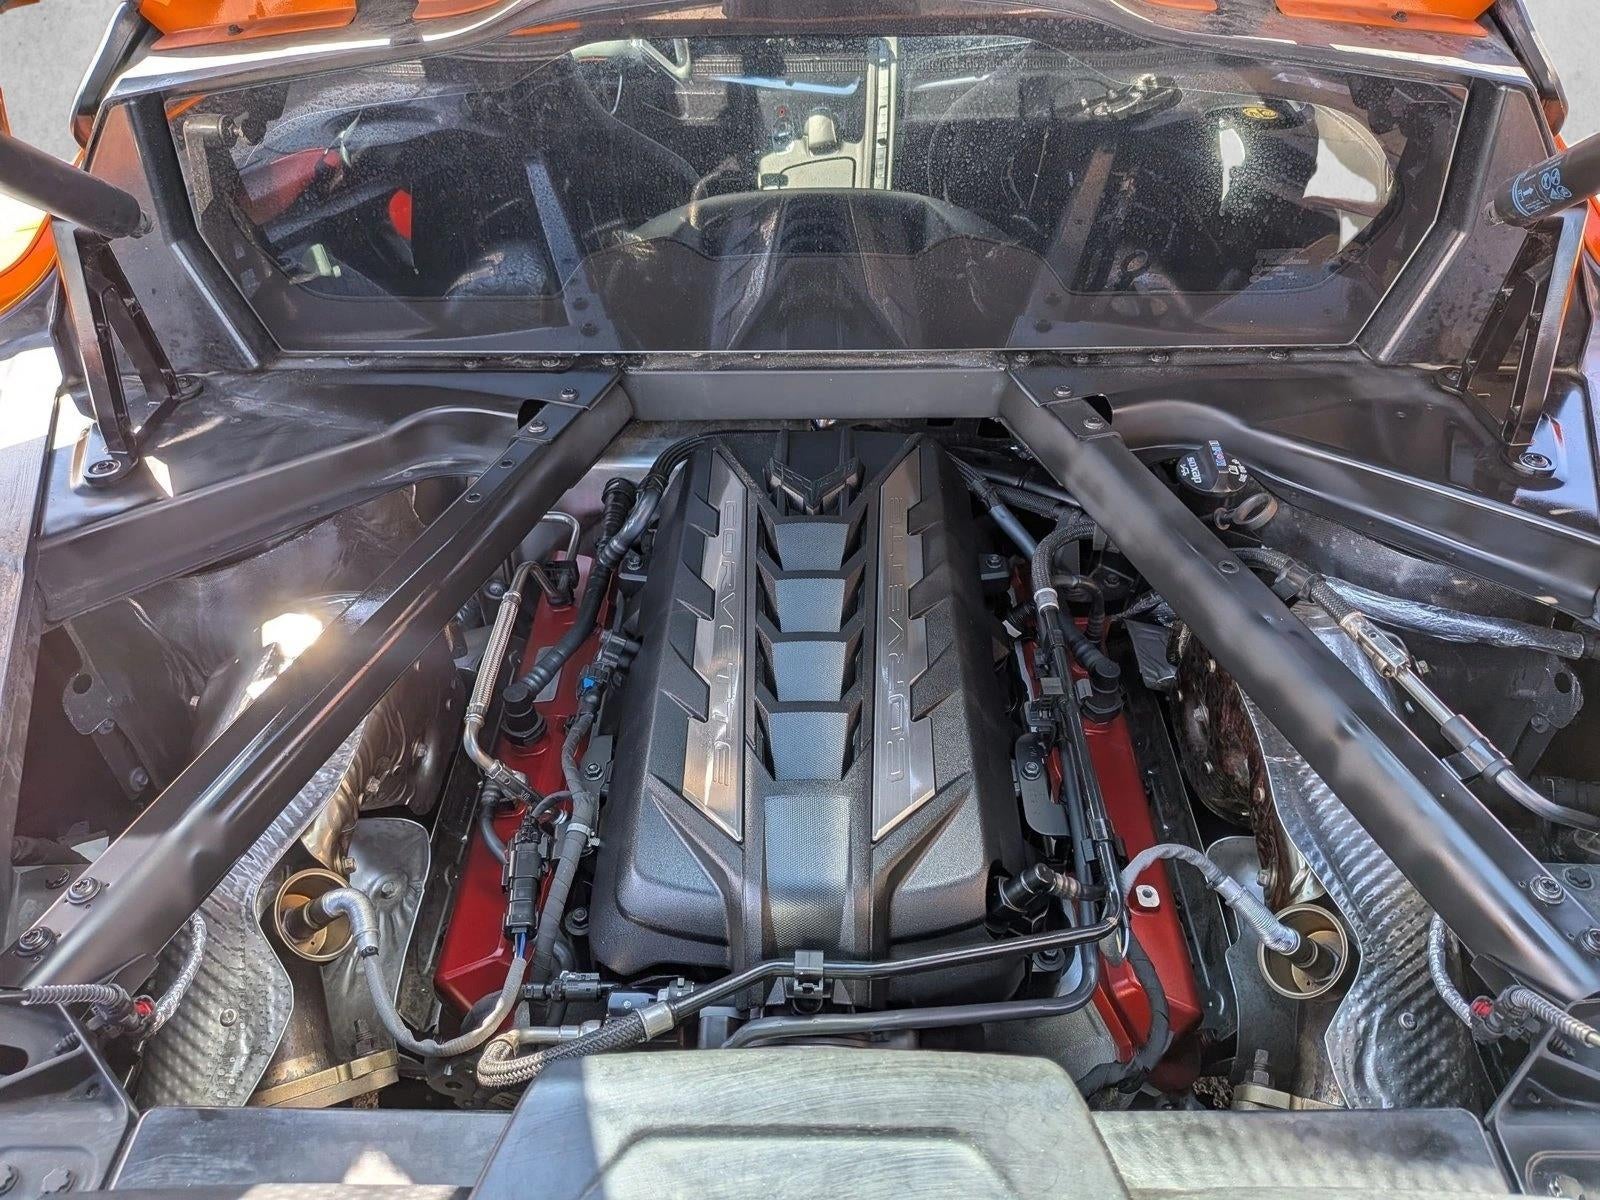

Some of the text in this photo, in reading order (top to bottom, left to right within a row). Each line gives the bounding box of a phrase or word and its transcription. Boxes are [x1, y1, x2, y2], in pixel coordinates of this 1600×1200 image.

[1187, 456, 1202, 483] dexos
[711, 500, 738, 787] CORVETTE
[886, 496, 906, 784] CORVETTE
